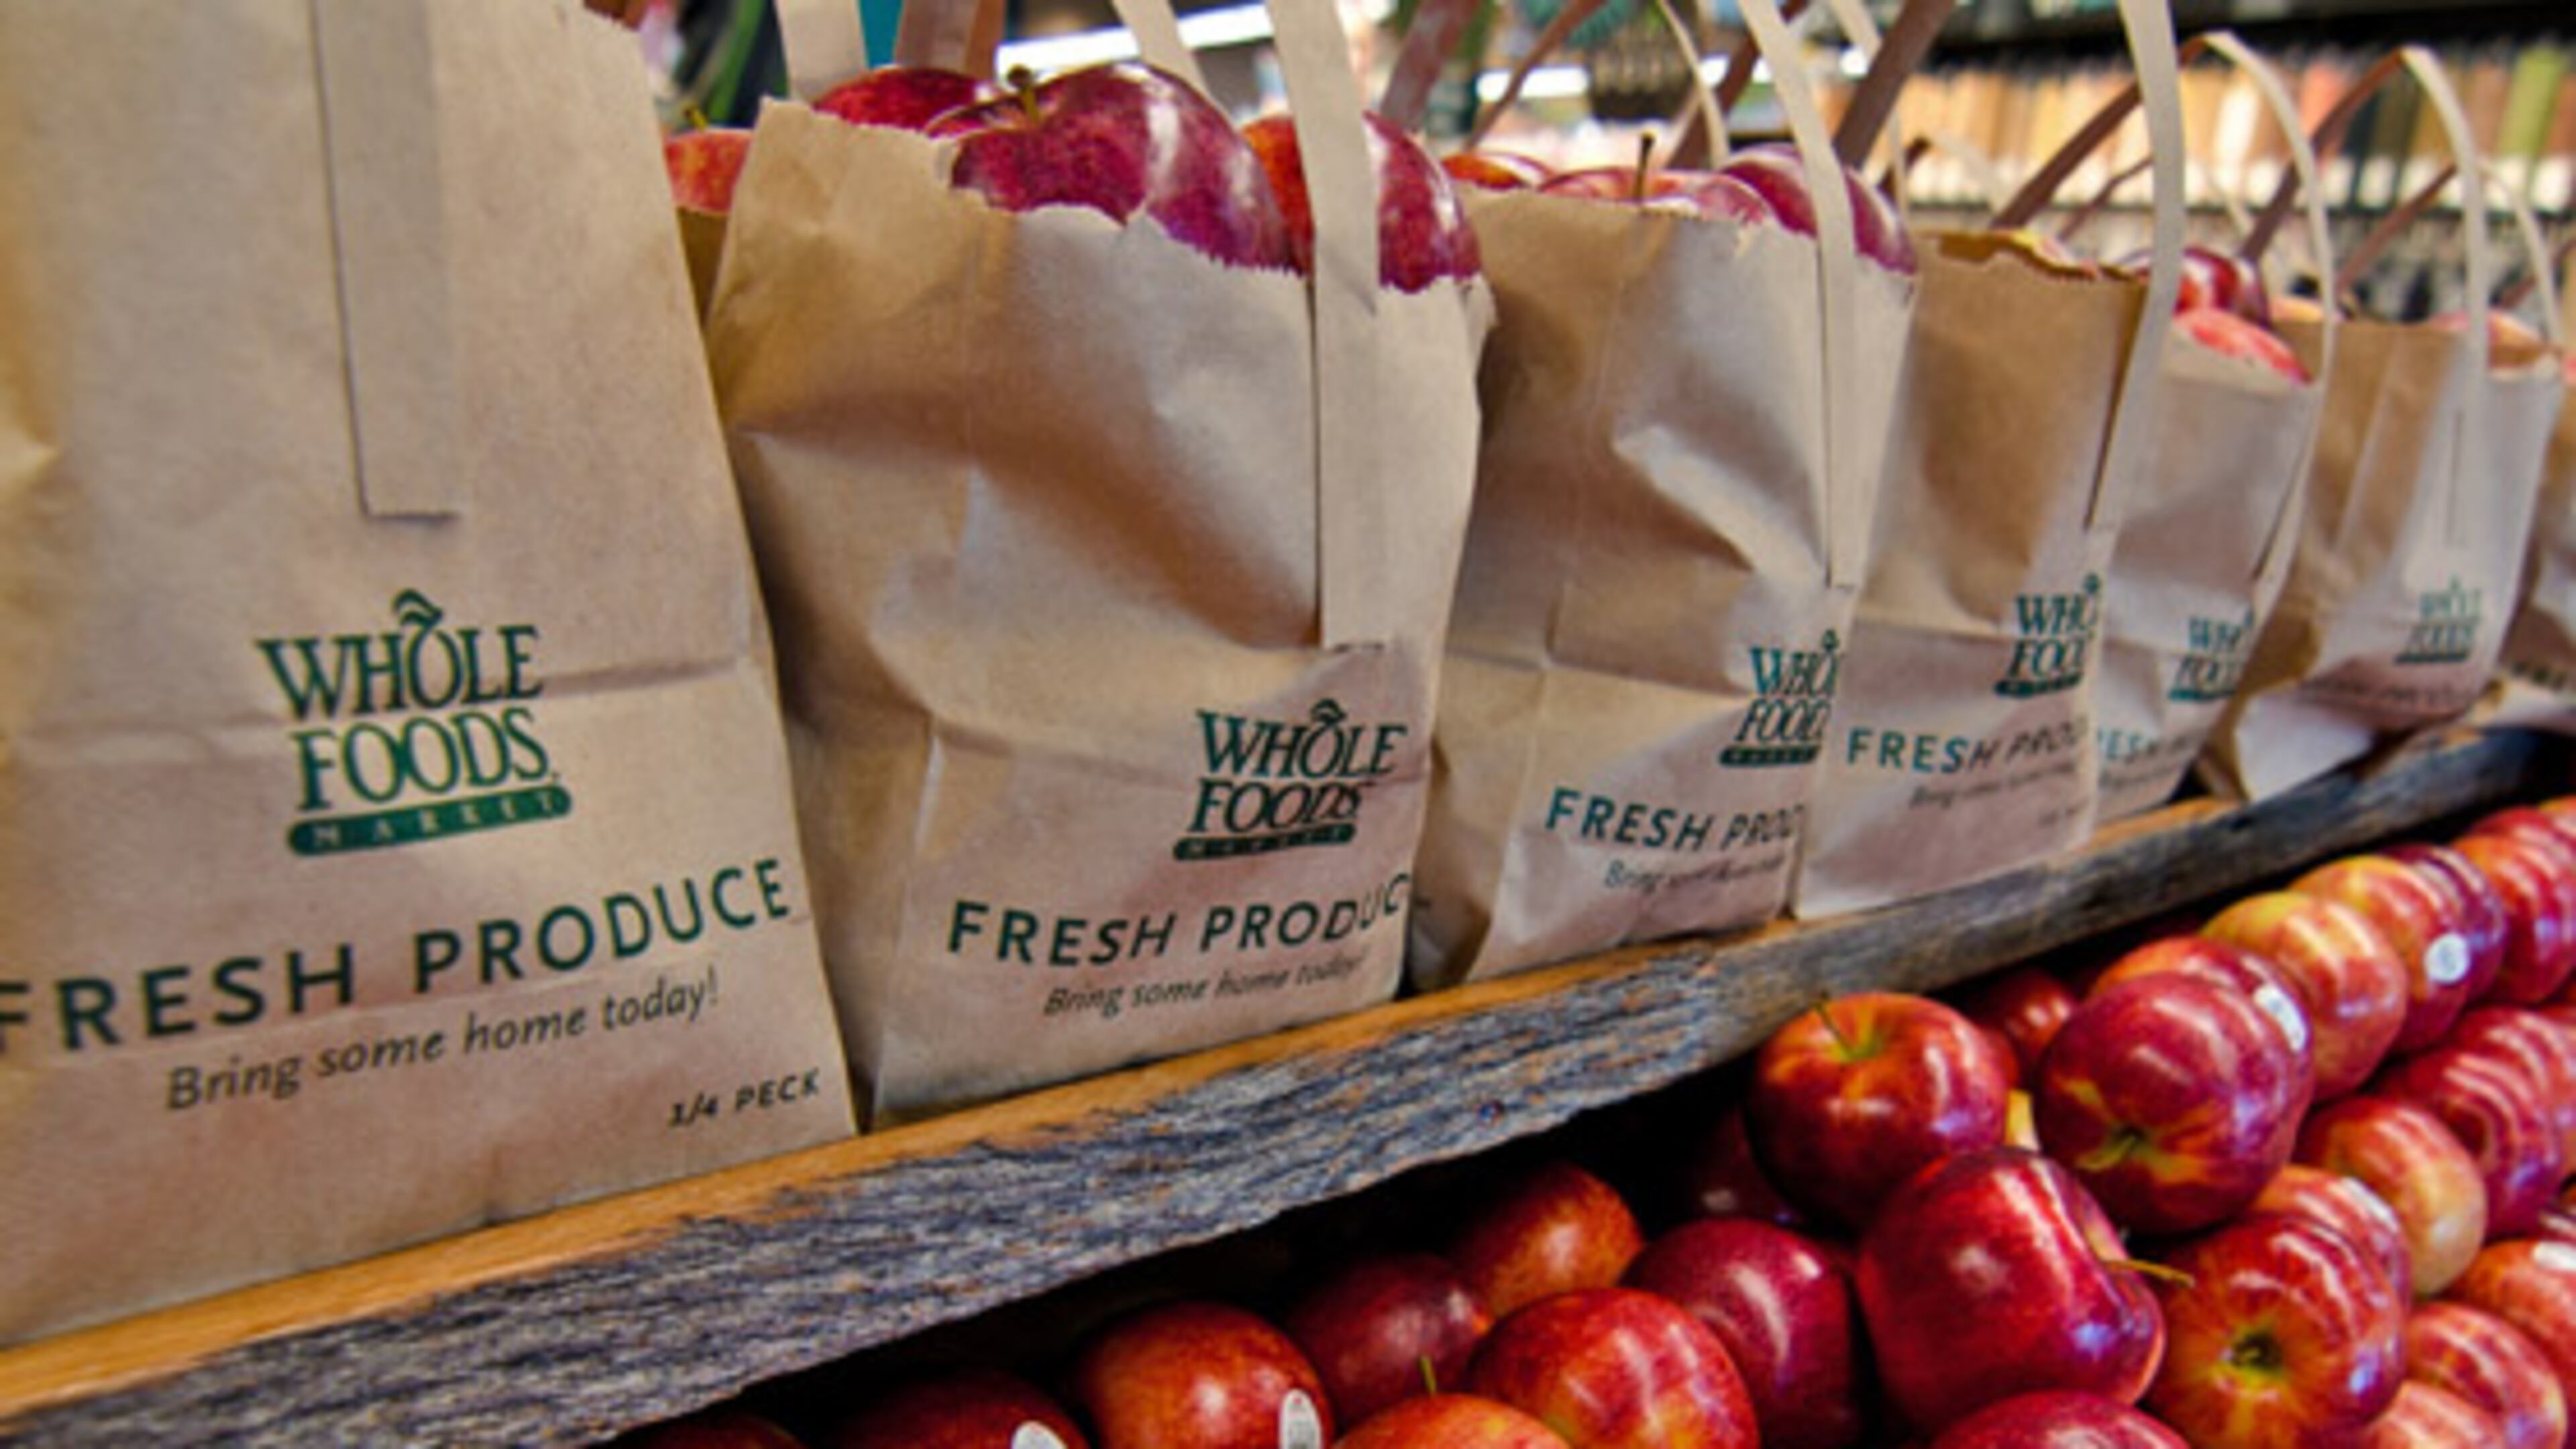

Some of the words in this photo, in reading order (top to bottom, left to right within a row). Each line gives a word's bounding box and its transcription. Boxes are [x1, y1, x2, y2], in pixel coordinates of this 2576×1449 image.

[254, 624, 544, 721] WHOLE
[288, 707, 551, 812] FOODS
[1195, 708, 1407, 778] WHOLE
[1847, 727, 2002, 774] FRESH
[311, 792, 559, 849] MARKET
[1187, 777, 1362, 833] FOODS
[1545, 786, 1715, 852] FRESH
[0, 942, 355, 1054] FRESH
[413, 857, 792, 995] PRODUCE
[947, 900, 1178, 967] FRESH
[1042, 987, 1124, 1018] Bring
[1130, 980, 1208, 1007] some
[1215, 970, 1290, 998] home
[167, 1053, 302, 1110] Bring
[316, 1030, 447, 1078] some
[464, 1010, 587, 1055] home
[602, 963, 718, 1030] today!
[668, 1089, 720, 1128] 1/4
[733, 1066, 820, 1112] PECK
